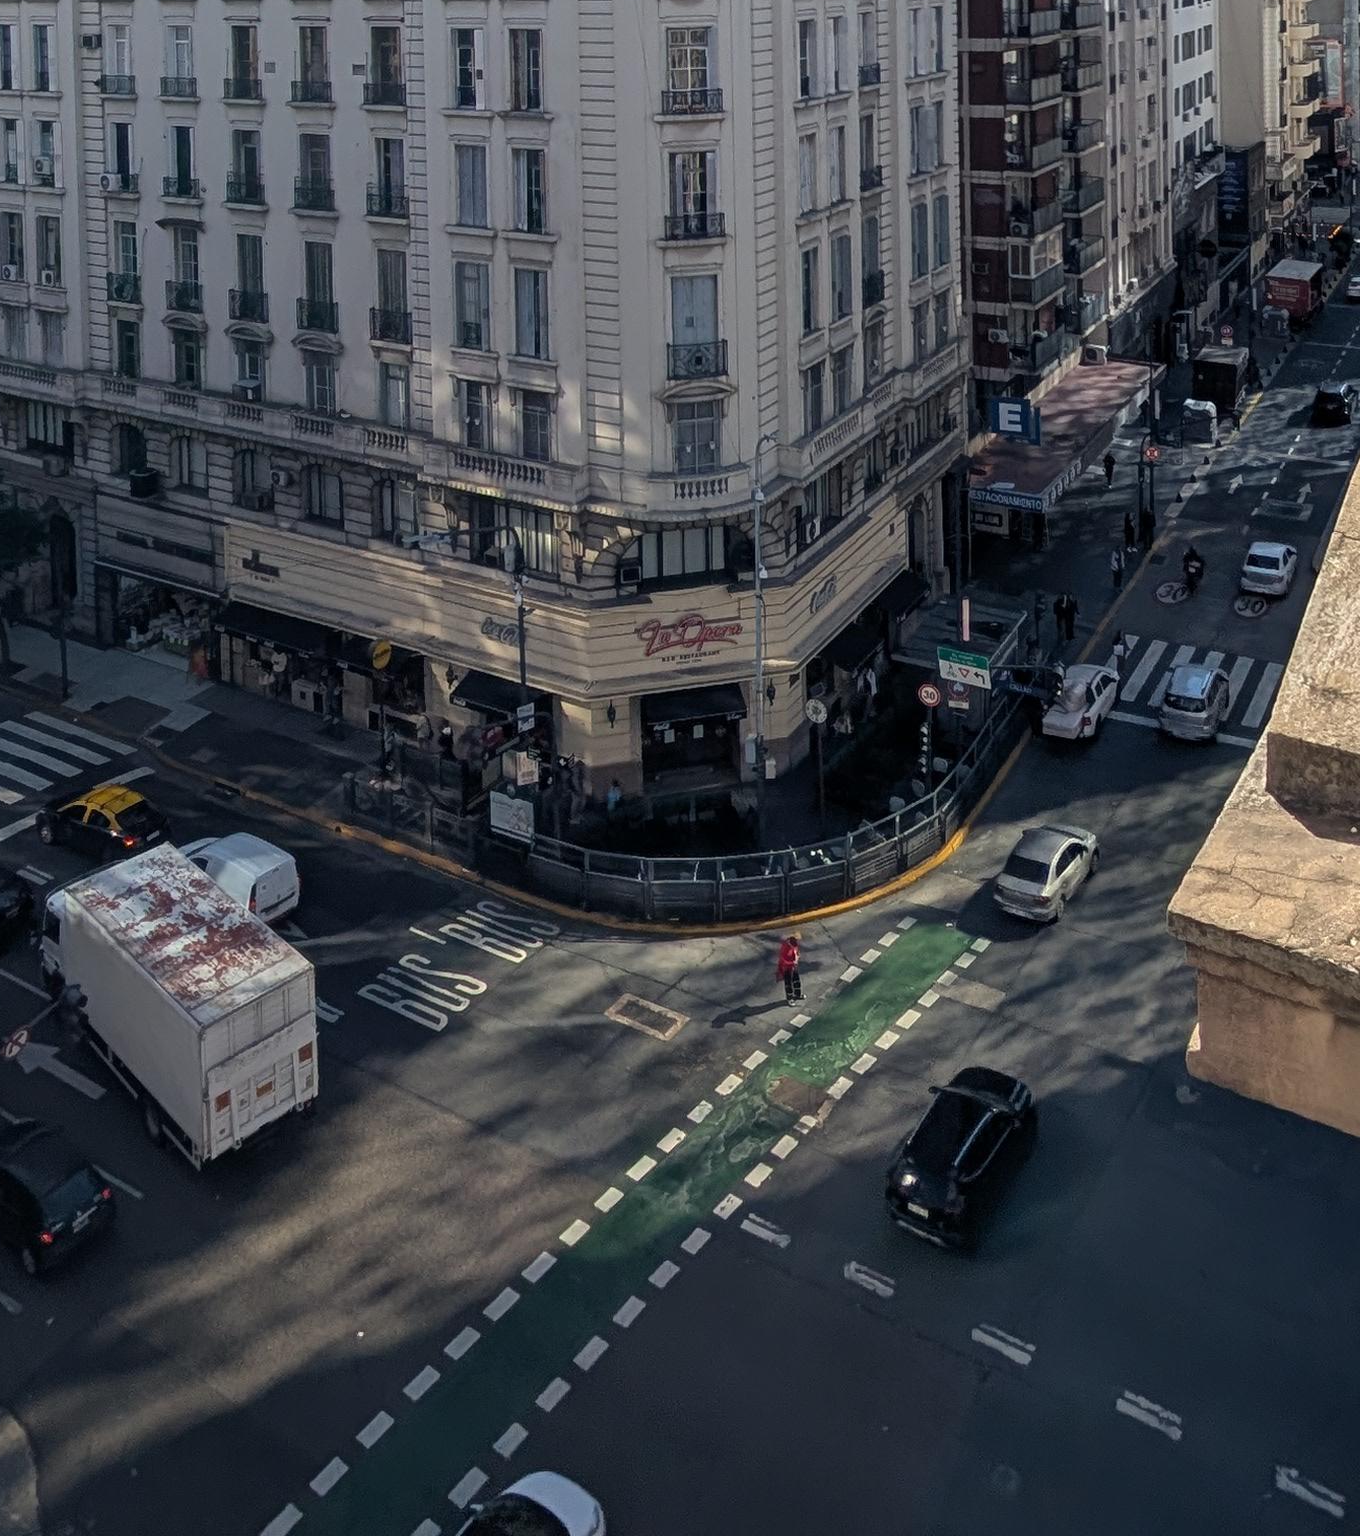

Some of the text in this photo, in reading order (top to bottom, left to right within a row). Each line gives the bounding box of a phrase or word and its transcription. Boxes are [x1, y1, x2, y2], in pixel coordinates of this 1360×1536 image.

[998, 402, 1022, 432] E
[1237, 598, 1265, 614] 30
[923, 690, 936, 700] 30
[439, 900, 561, 964] BUS
[356, 953, 488, 1033] BUS
